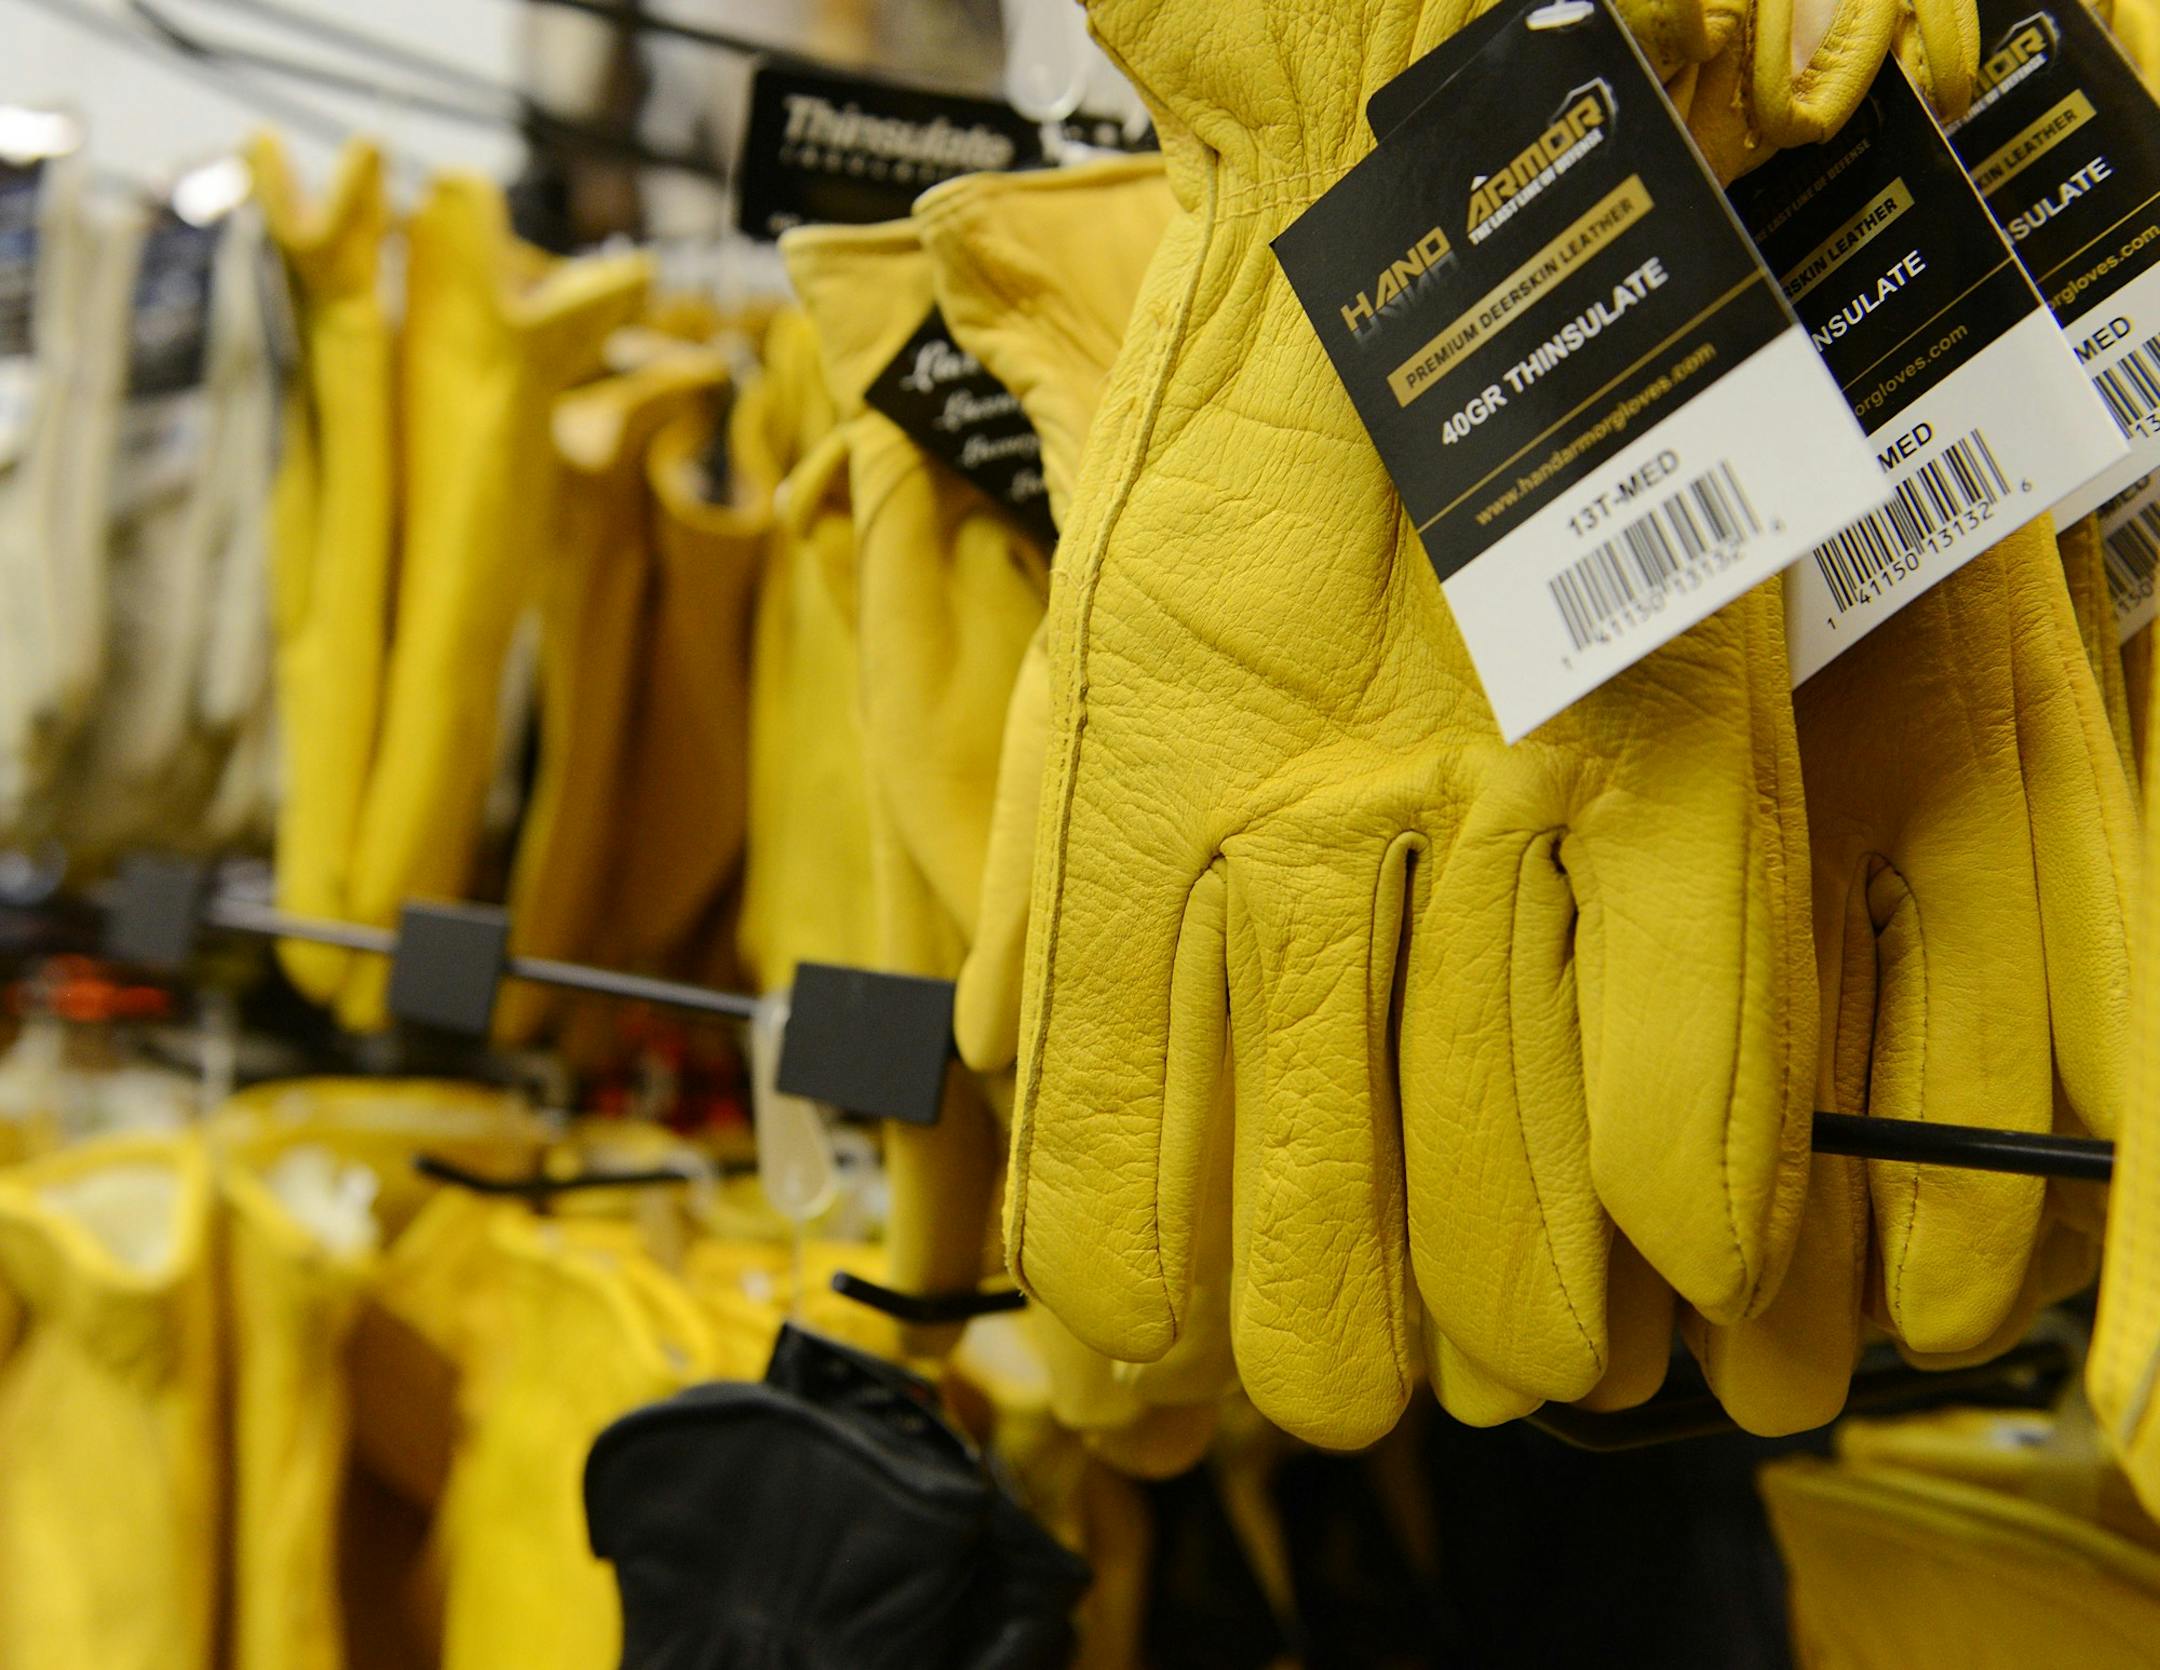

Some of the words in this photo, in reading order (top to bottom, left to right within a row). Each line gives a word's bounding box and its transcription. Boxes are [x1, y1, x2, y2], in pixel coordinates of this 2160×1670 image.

[2006, 109, 2079, 171] LEATHER
[1340, 226, 1454, 334] HAND
[1467, 95, 1605, 234] ARMOR
[1828, 198, 1898, 262] LEATHER
[2003, 156, 2114, 246] SULATE
[1406, 324, 1480, 389] PREMIUM
[1481, 258, 1559, 332] DEERSKIN
[1559, 195, 1637, 270] LEATHER
[1441, 382, 1508, 446] 40GR
[1502, 256, 1670, 395] THINSULATE
[1855, 322, 1968, 418] orgloves.com
[1474, 342, 1718, 527] www.handarmorgloves.com
[1876, 421, 1934, 474] MED
[1568, 448, 1681, 537] 13T-MED
[1857, 551, 1921, 605] 41150
[1926, 500, 1995, 555] 13132
[2021, 480, 2032, 493] 6
